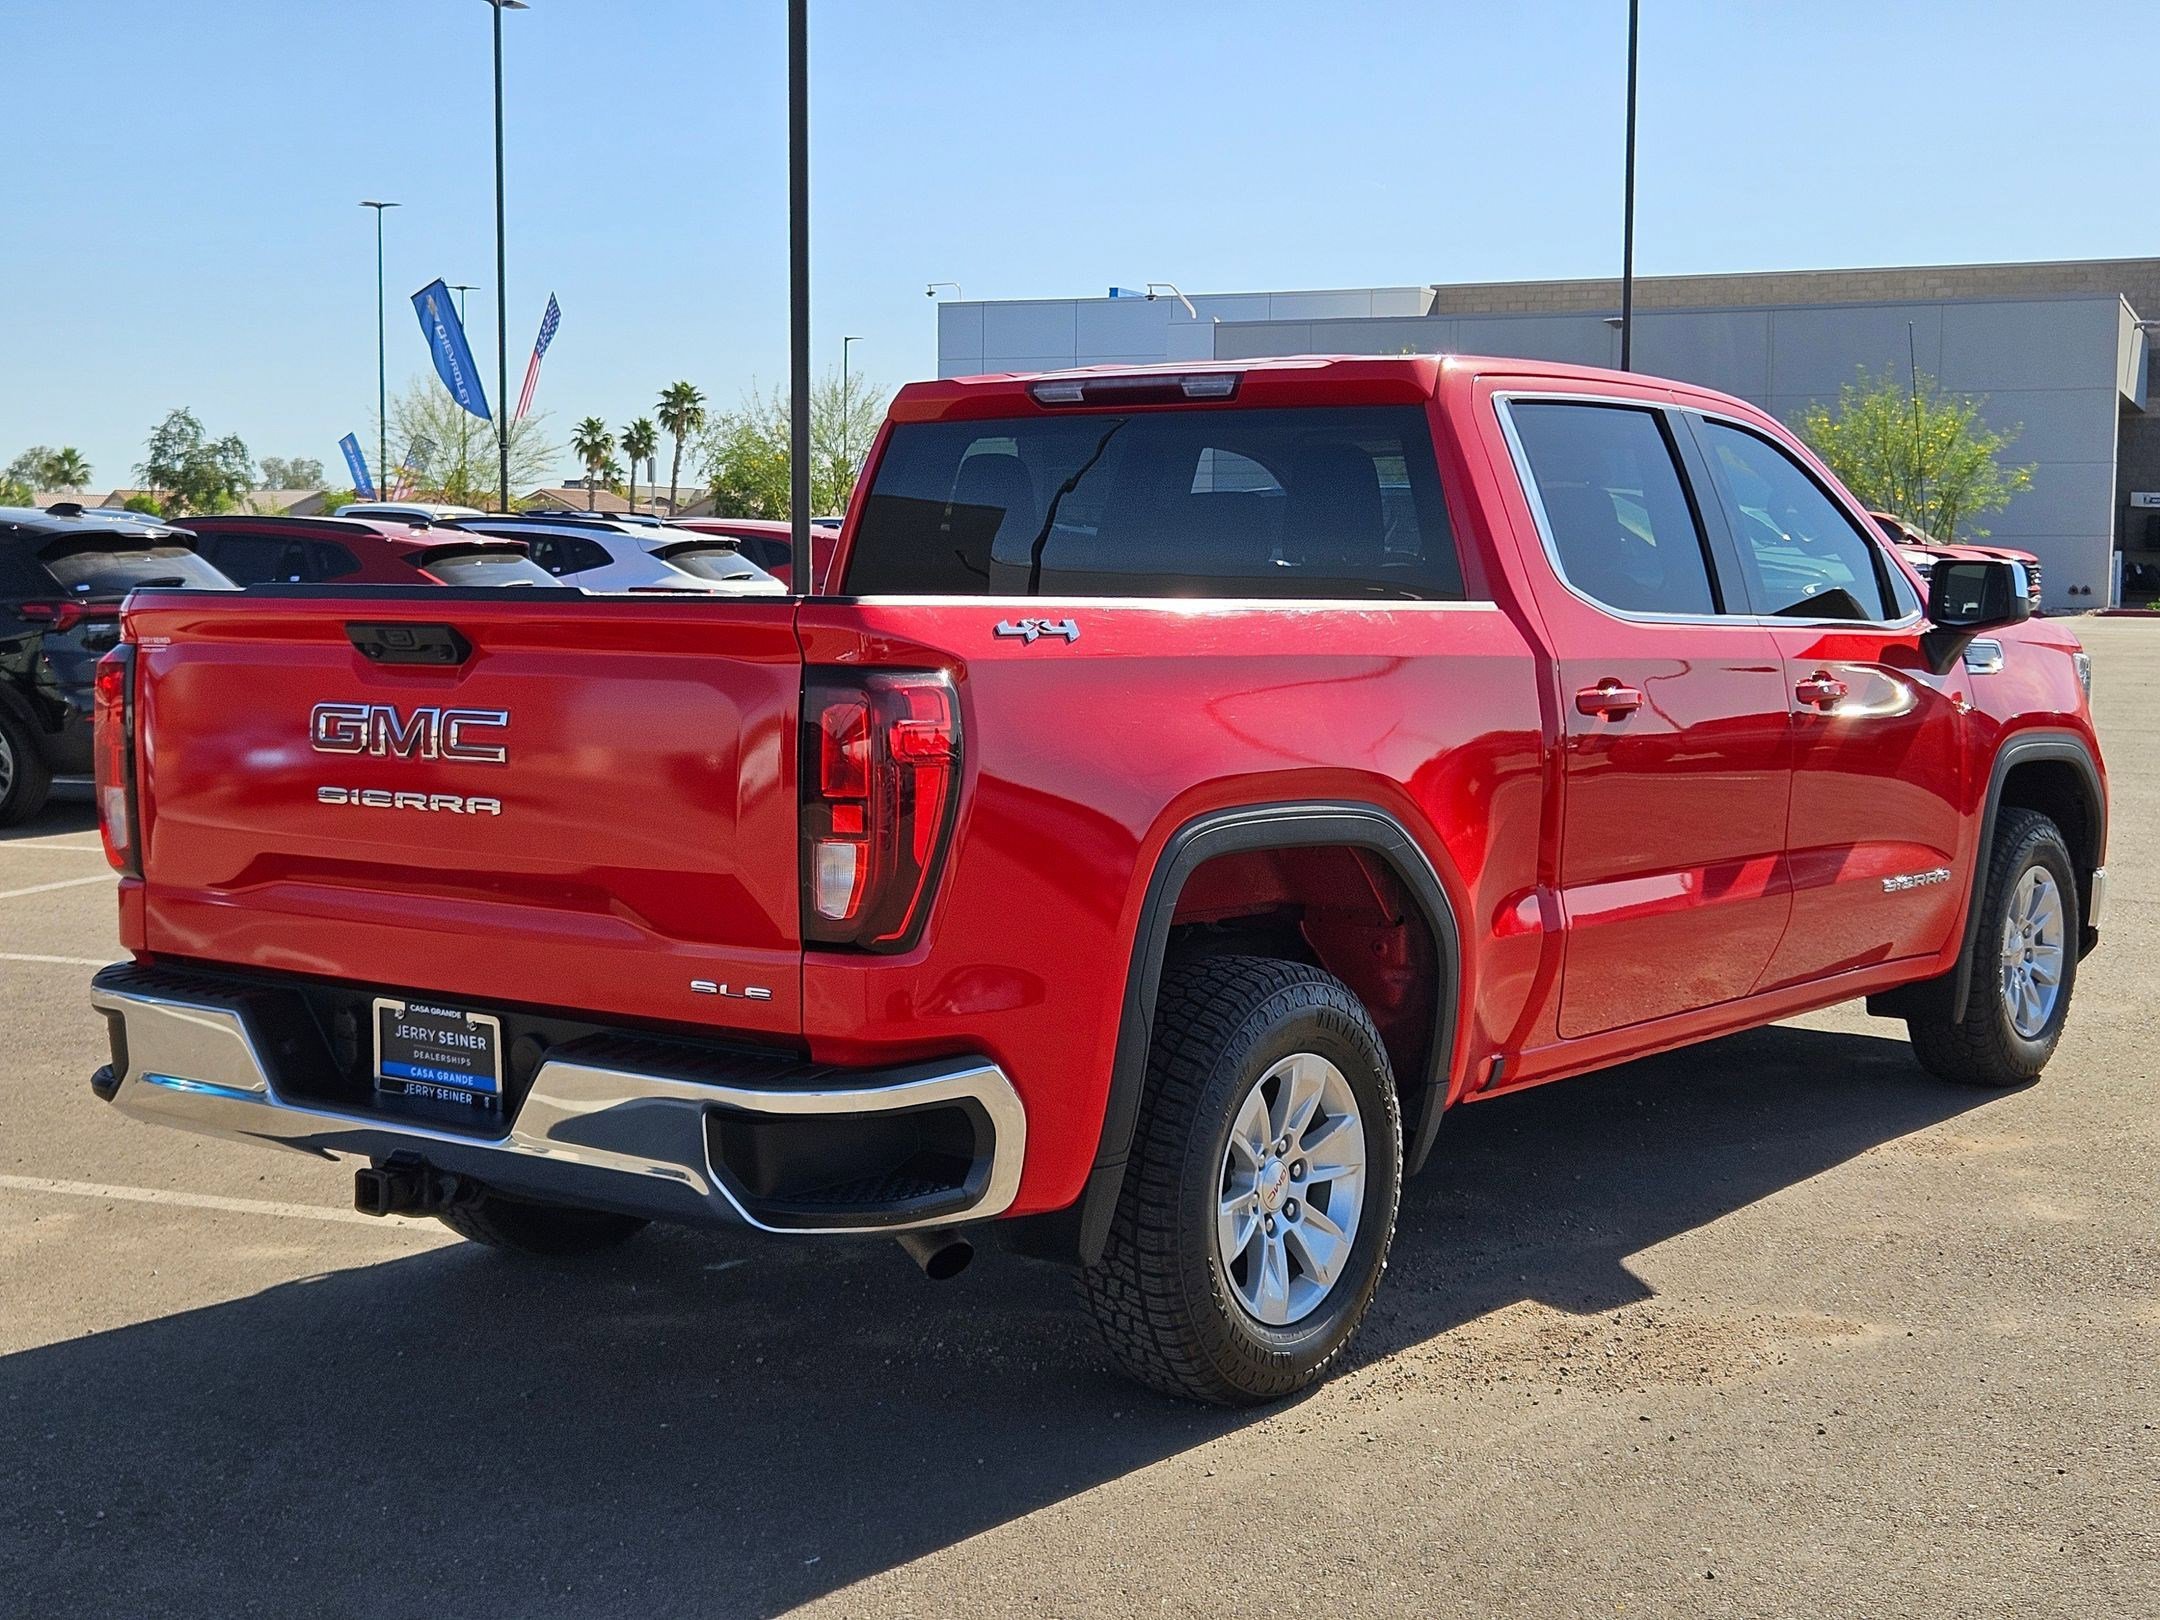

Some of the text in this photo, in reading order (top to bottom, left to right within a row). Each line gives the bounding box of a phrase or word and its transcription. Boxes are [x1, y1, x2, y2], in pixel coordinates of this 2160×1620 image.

[435, 324, 471, 406] CHEVROLET
[311, 703, 508, 763] GMC
[317, 786, 501, 816] SIERRA
[1882, 867, 1951, 892] SIERRA
[690, 980, 772, 1000] SLE
[409, 1004, 462, 1019] CASA GRANDE
[395, 1025, 487, 1050] JERRY SEINER
[413, 1050, 472, 1067] DEALERSHIPS
[410, 1067, 474, 1086] CASA GRANDE
[404, 1083, 473, 1105] JERRY SEINER
[1267, 1169, 1287, 1203] GMC
